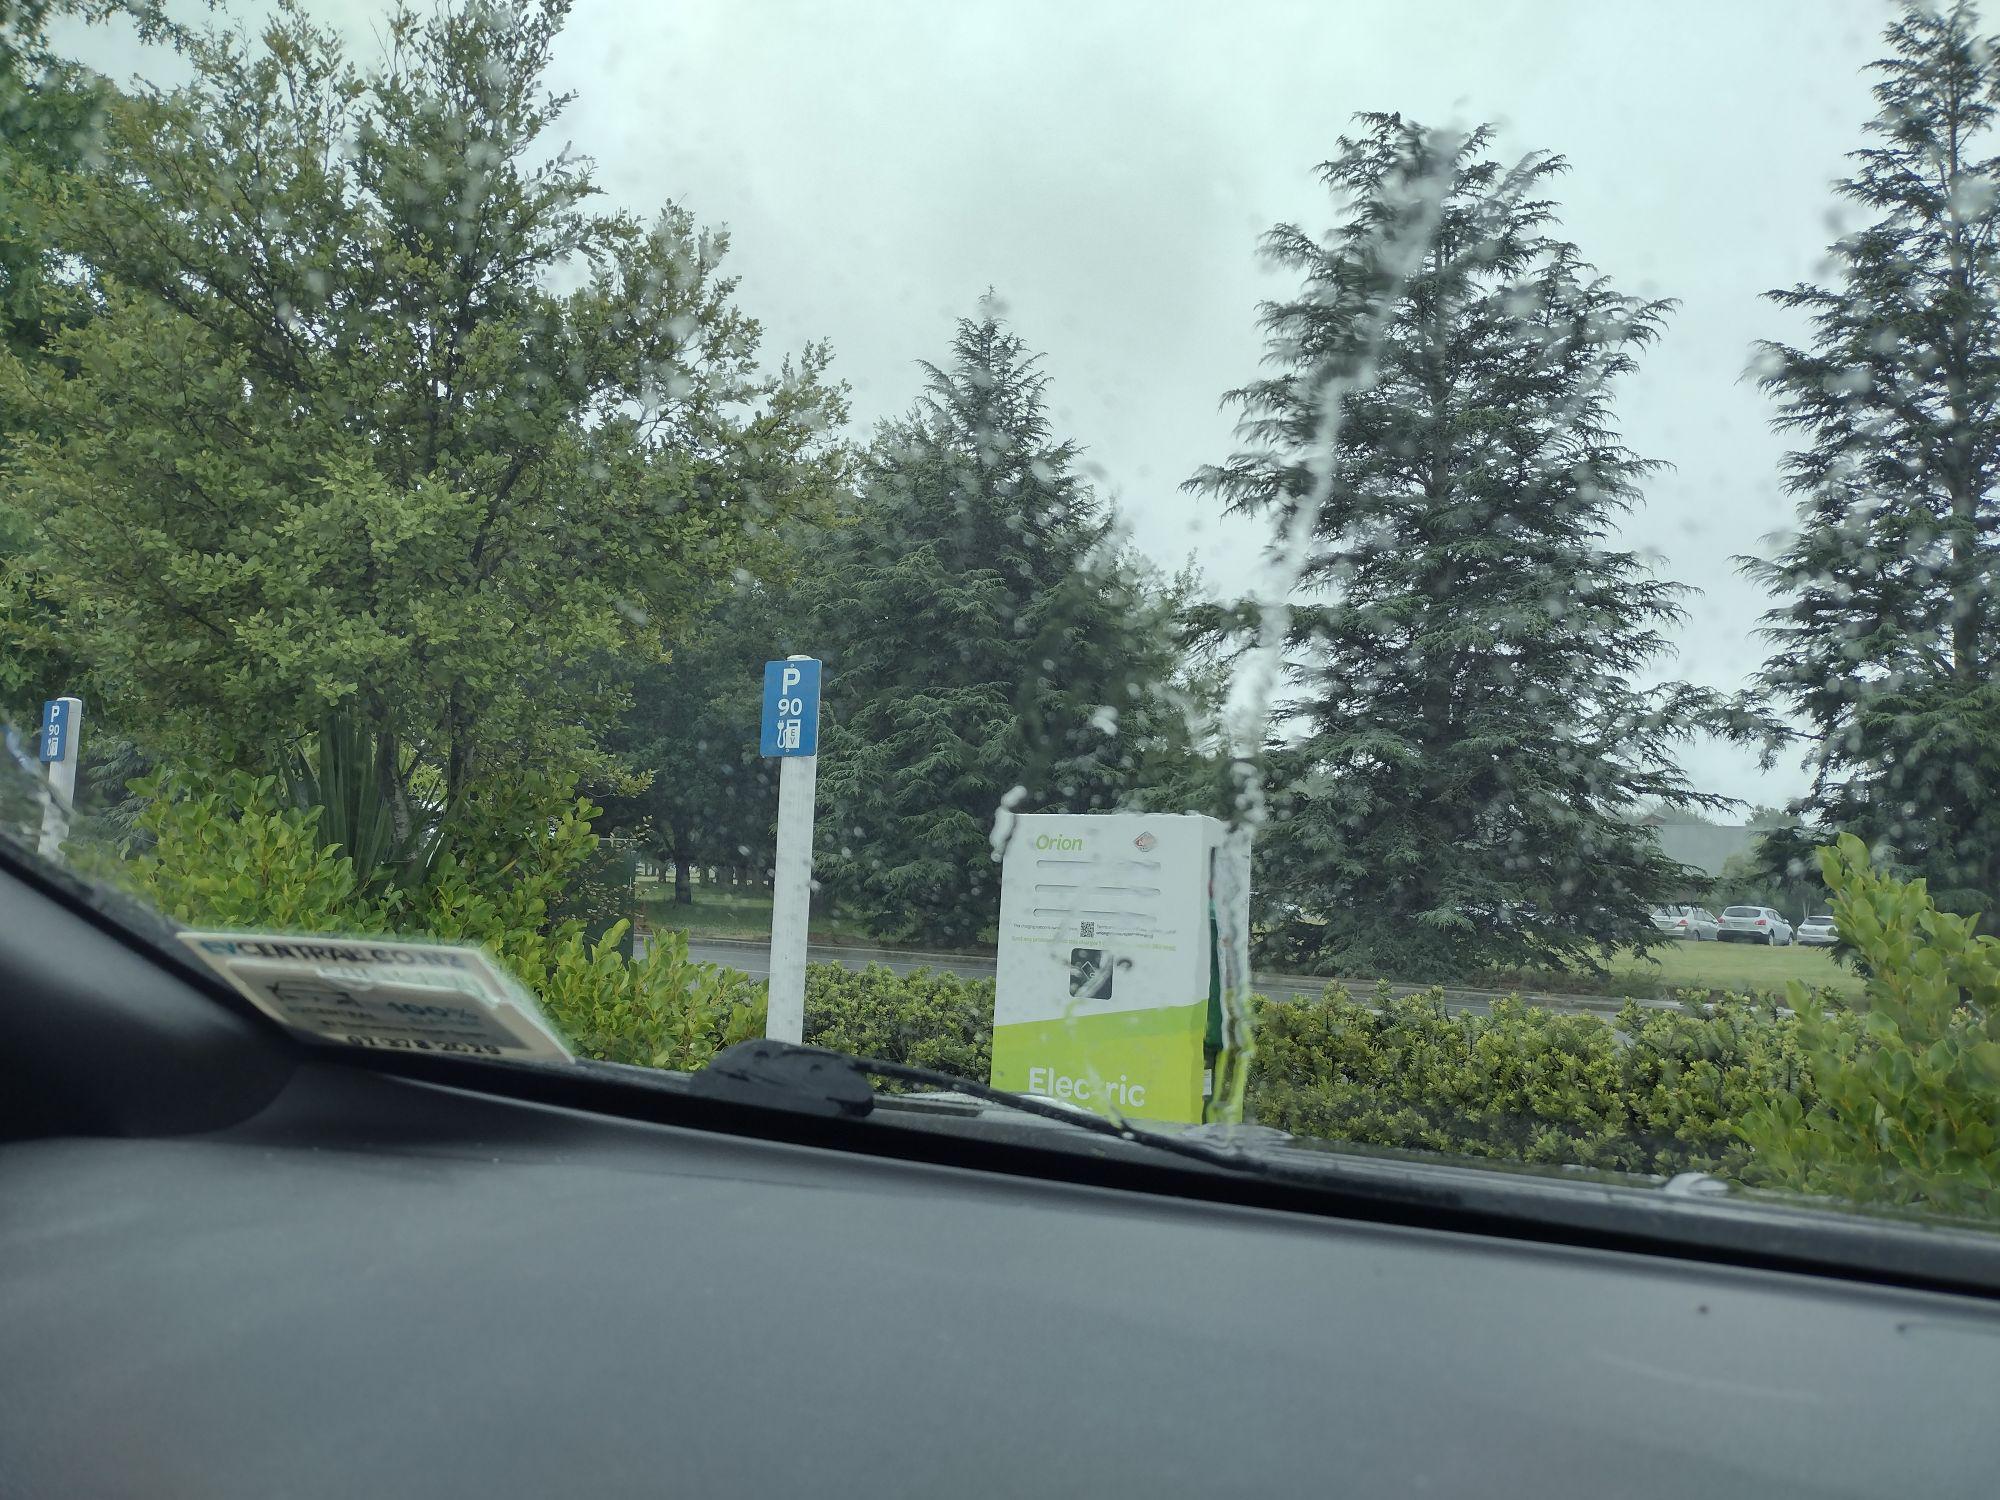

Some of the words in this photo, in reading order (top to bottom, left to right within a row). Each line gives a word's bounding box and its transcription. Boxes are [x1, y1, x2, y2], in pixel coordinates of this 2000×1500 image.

[782, 668, 801, 695] P
[50, 705, 60, 723] P
[777, 698, 803, 717] 90
[48, 724, 60, 736] 90
[1036, 833, 1083, 851] Orion
[1029, 1066, 1146, 1108] Elecric
